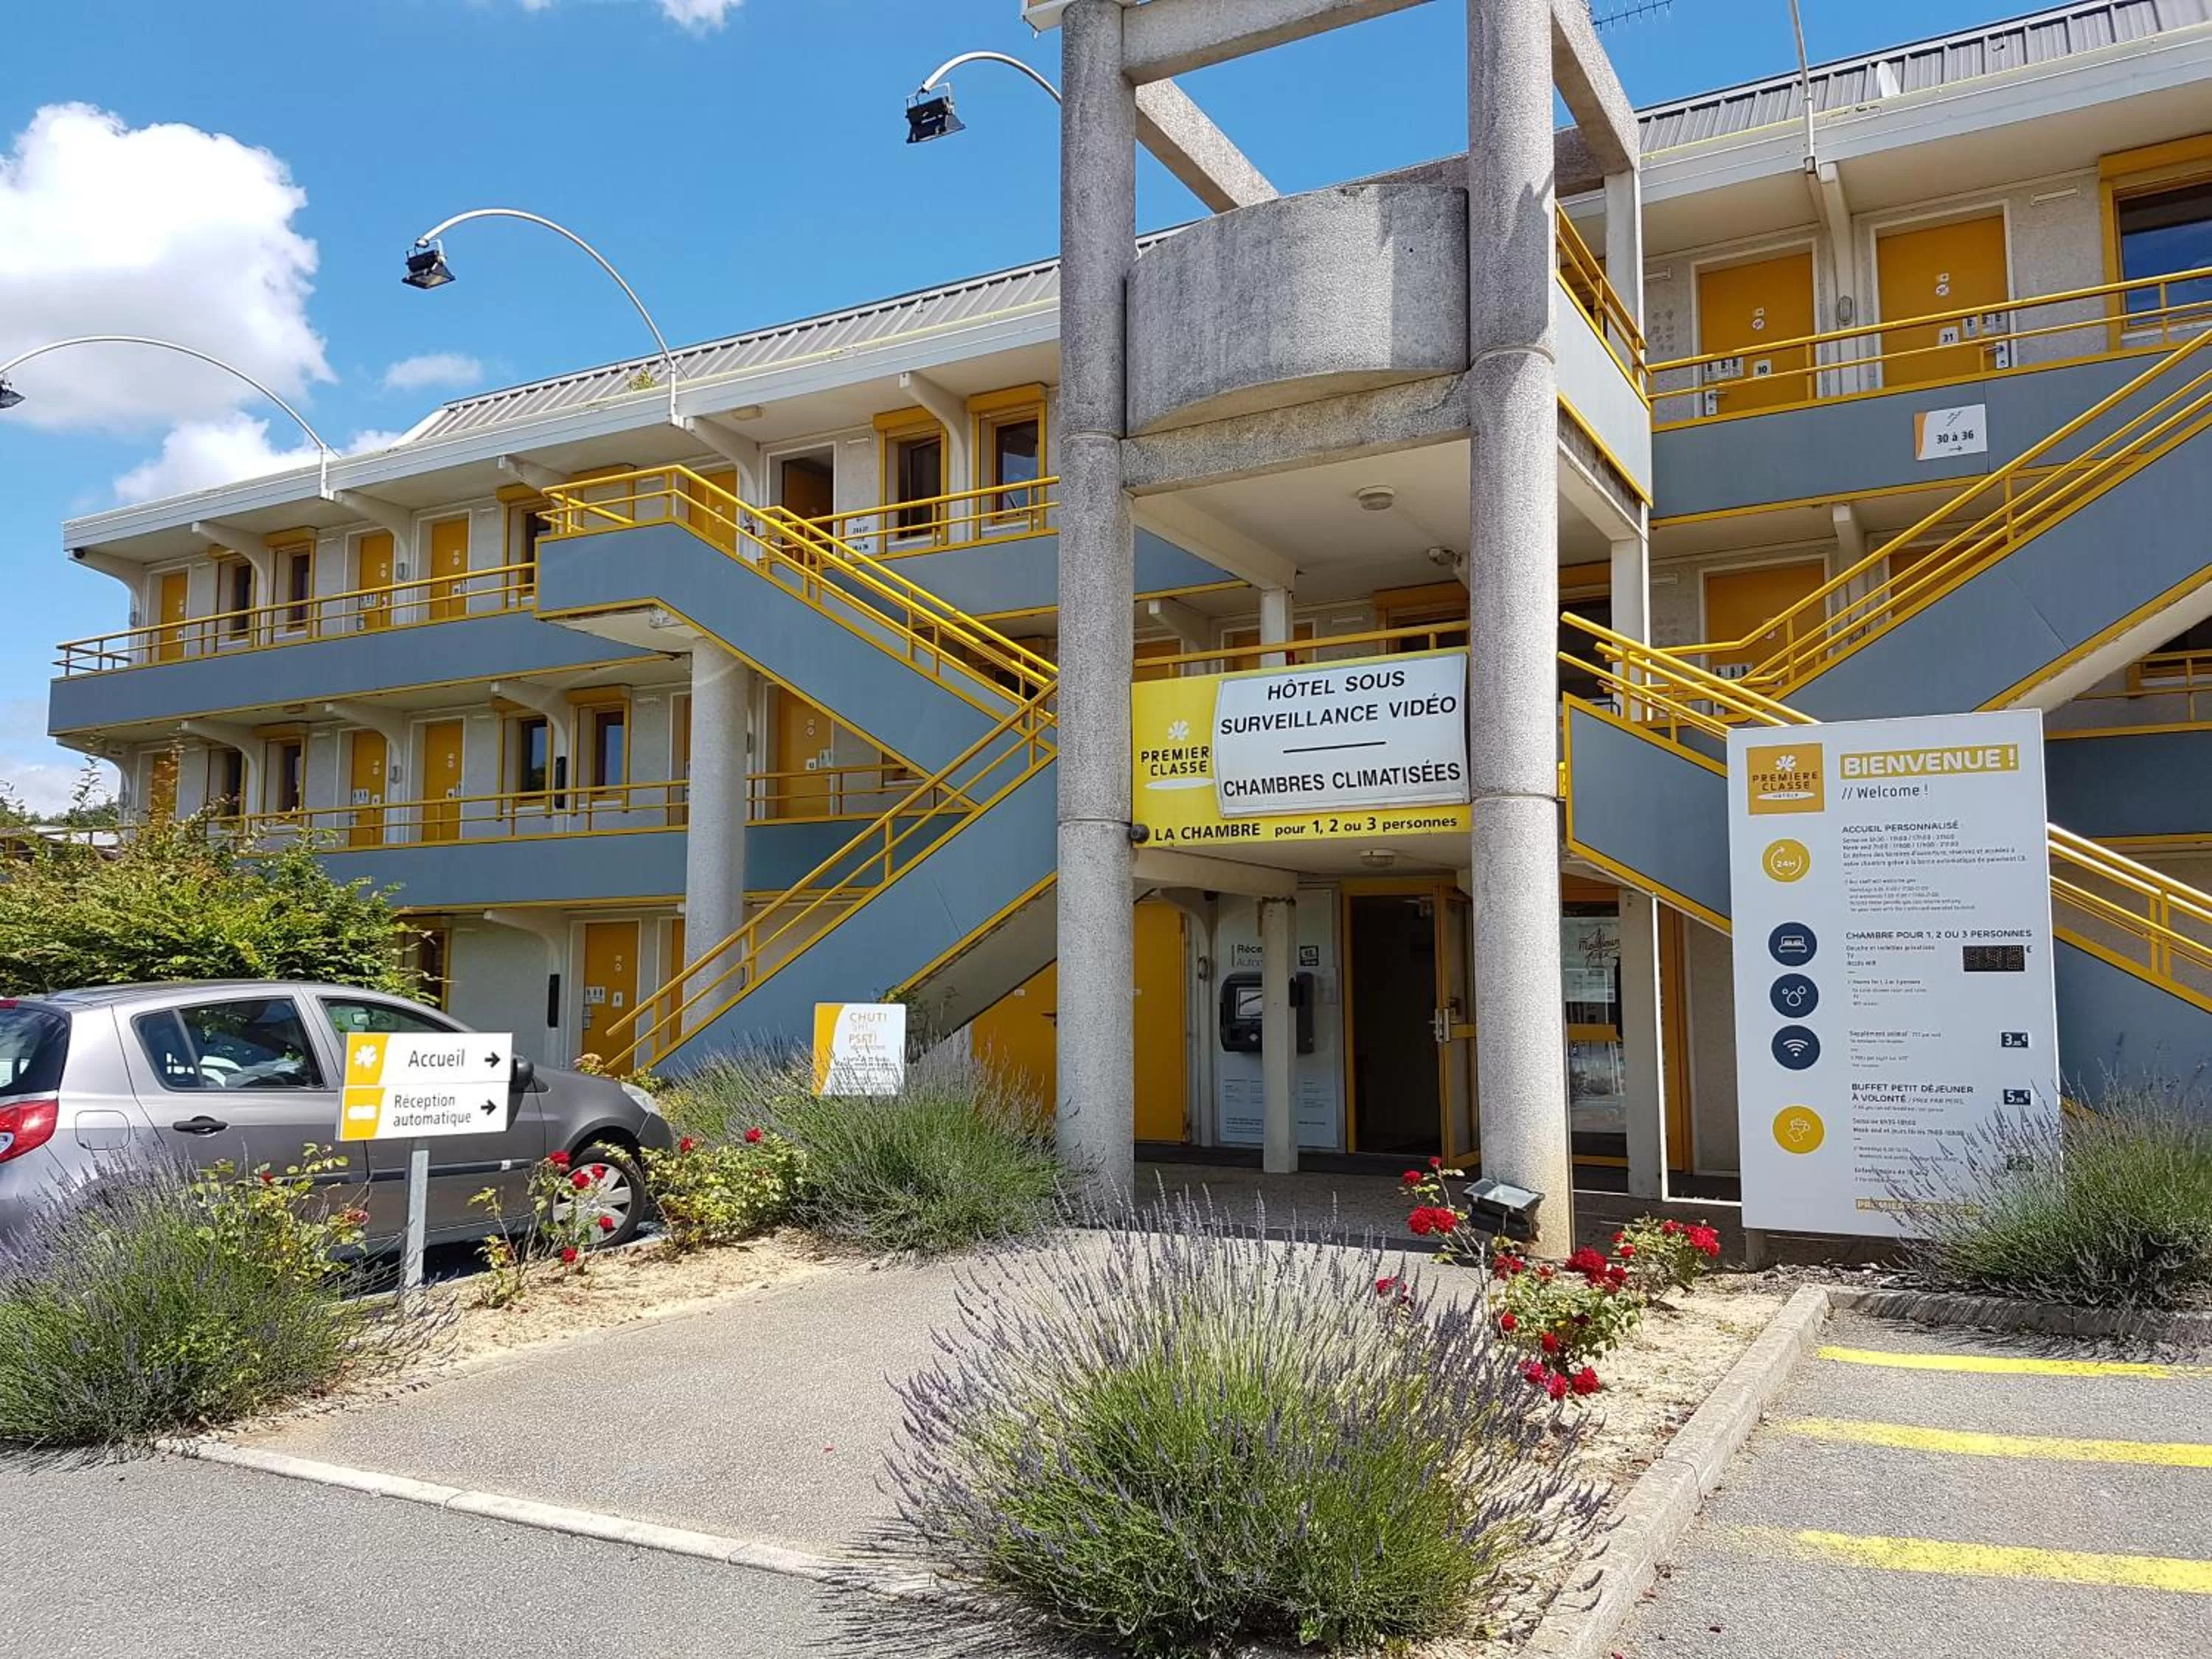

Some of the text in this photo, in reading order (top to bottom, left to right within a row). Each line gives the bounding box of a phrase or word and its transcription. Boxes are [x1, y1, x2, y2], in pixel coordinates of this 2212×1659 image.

[1943, 333, 1953, 343] 31
[1936, 430, 1974, 444] 30 à 36
[1267, 670, 1405, 700] HÔTEL SOUS
[1220, 693, 1457, 734] SURVEILLANCE VIDÉO
[1150, 760, 1207, 776] CLASSE
[1844, 748, 2001, 776] BIENVENUE
[1223, 759, 1461, 798] CHAMBRES CLIMATISÉES
[1753, 771, 1818, 783] PREMIERE
[1761, 781, 1811, 792] CLASSE
[1857, 785, 1920, 799] Welcome
[1155, 816, 1458, 842] LA CHAMBRE pour 1, 2 ou 3 personnes
[1842, 820, 1959, 834] ACCUEIL PERSONNALISÉ
[1776, 859, 1796, 869] 24H
[1846, 931, 1893, 939] CHAMBRE
[1896, 931, 1924, 939] POUR
[1944, 931, 1958, 939] OU
[1961, 930, 1968, 939] 3
[1971, 929, 2033, 939] PERSONNES
[408, 1048, 465, 1068] Accueil
[1851, 1083, 1974, 1093] BUFFET PETIT DÉJEUNER
[394, 1094, 455, 1110] Réception
[1851, 1092, 1859, 1102] À
[1861, 1093, 1906, 1102] VOLONTÉ
[393, 1110, 471, 1127] automatique
